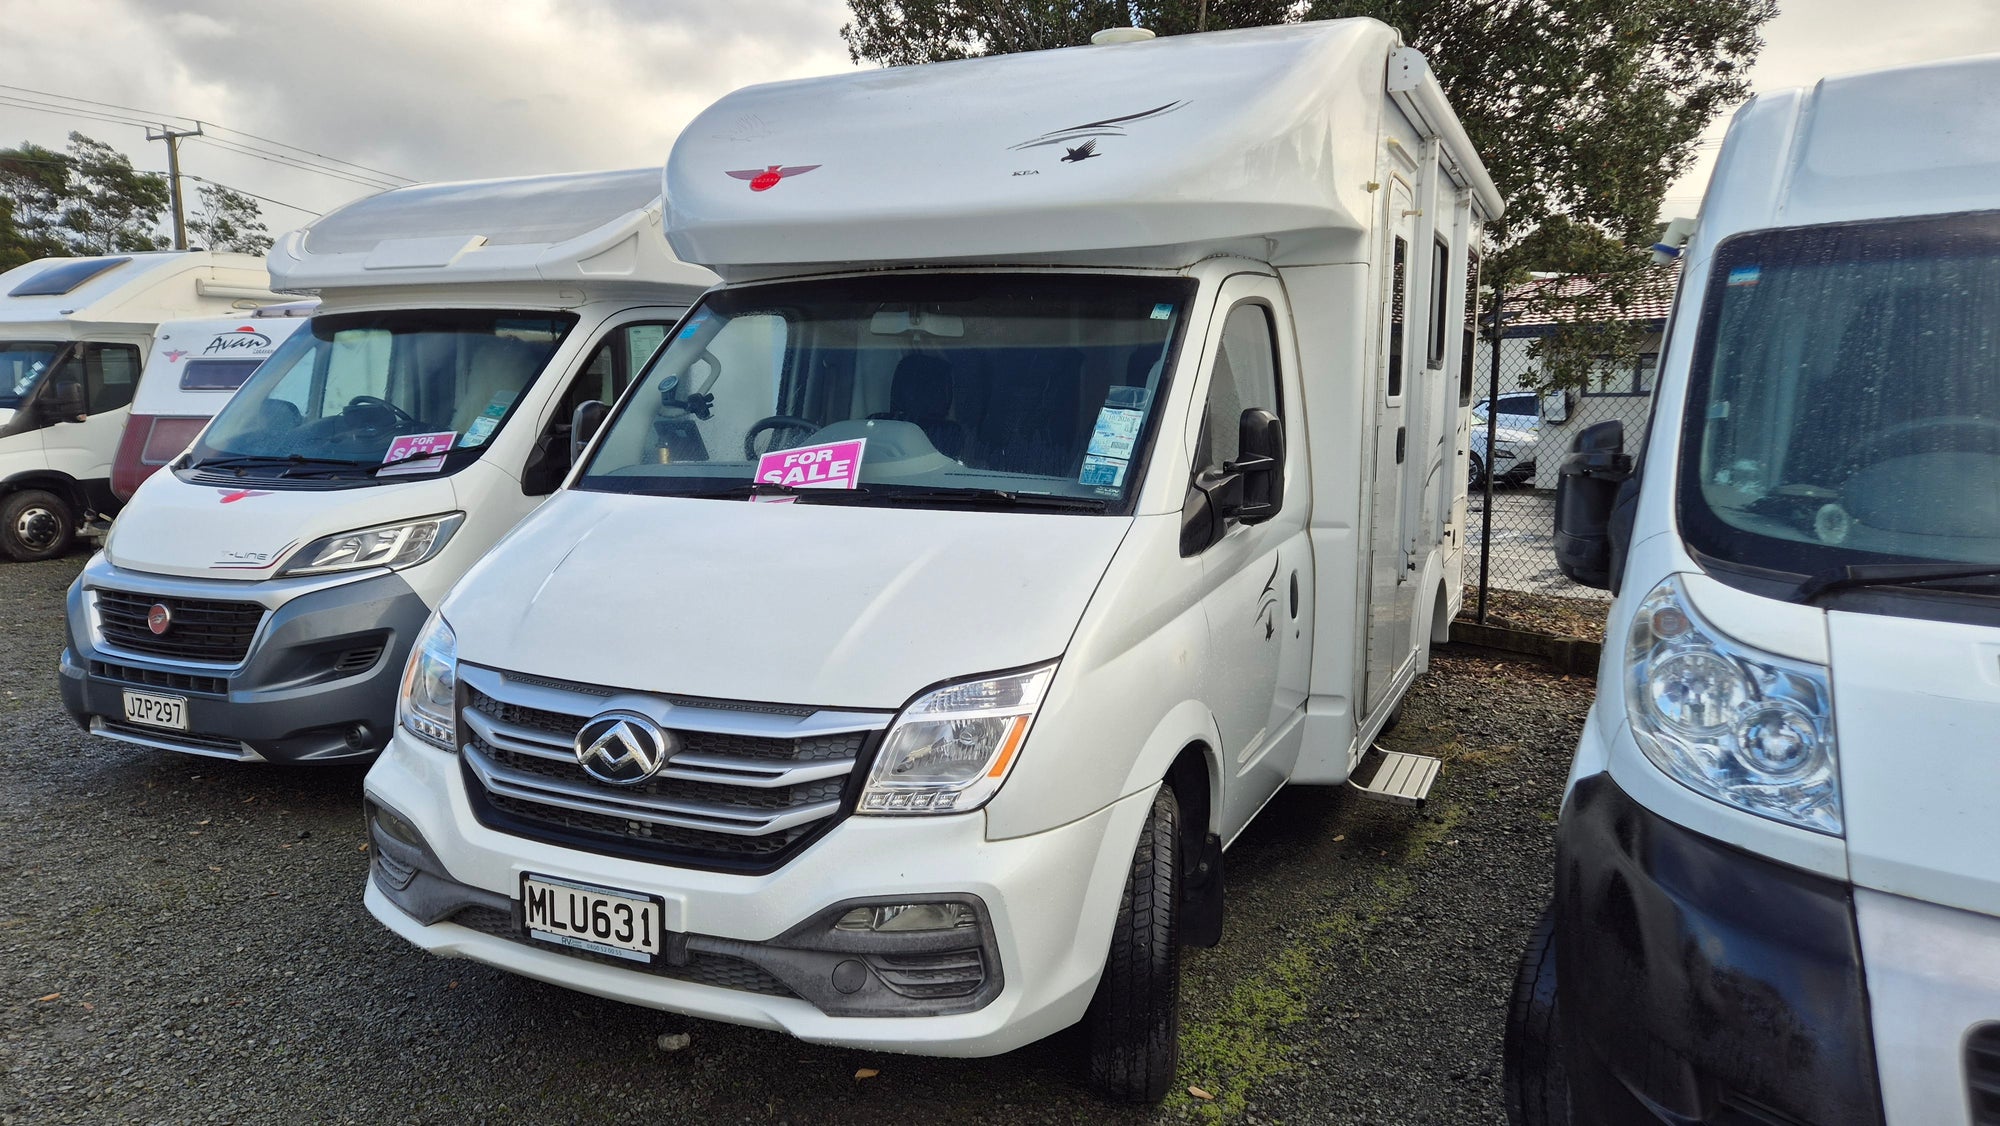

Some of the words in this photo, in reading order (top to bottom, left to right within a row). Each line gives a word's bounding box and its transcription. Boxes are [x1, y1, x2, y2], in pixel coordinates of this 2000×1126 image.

[203, 335, 264, 355] Avan
[410, 436, 435, 446] FOR
[784, 449, 833, 468] FOR
[763, 459, 851, 485] SALE
[127, 696, 181, 725] JZP297
[528, 885, 652, 947] MLU631
[561, 936, 572, 945] RV
